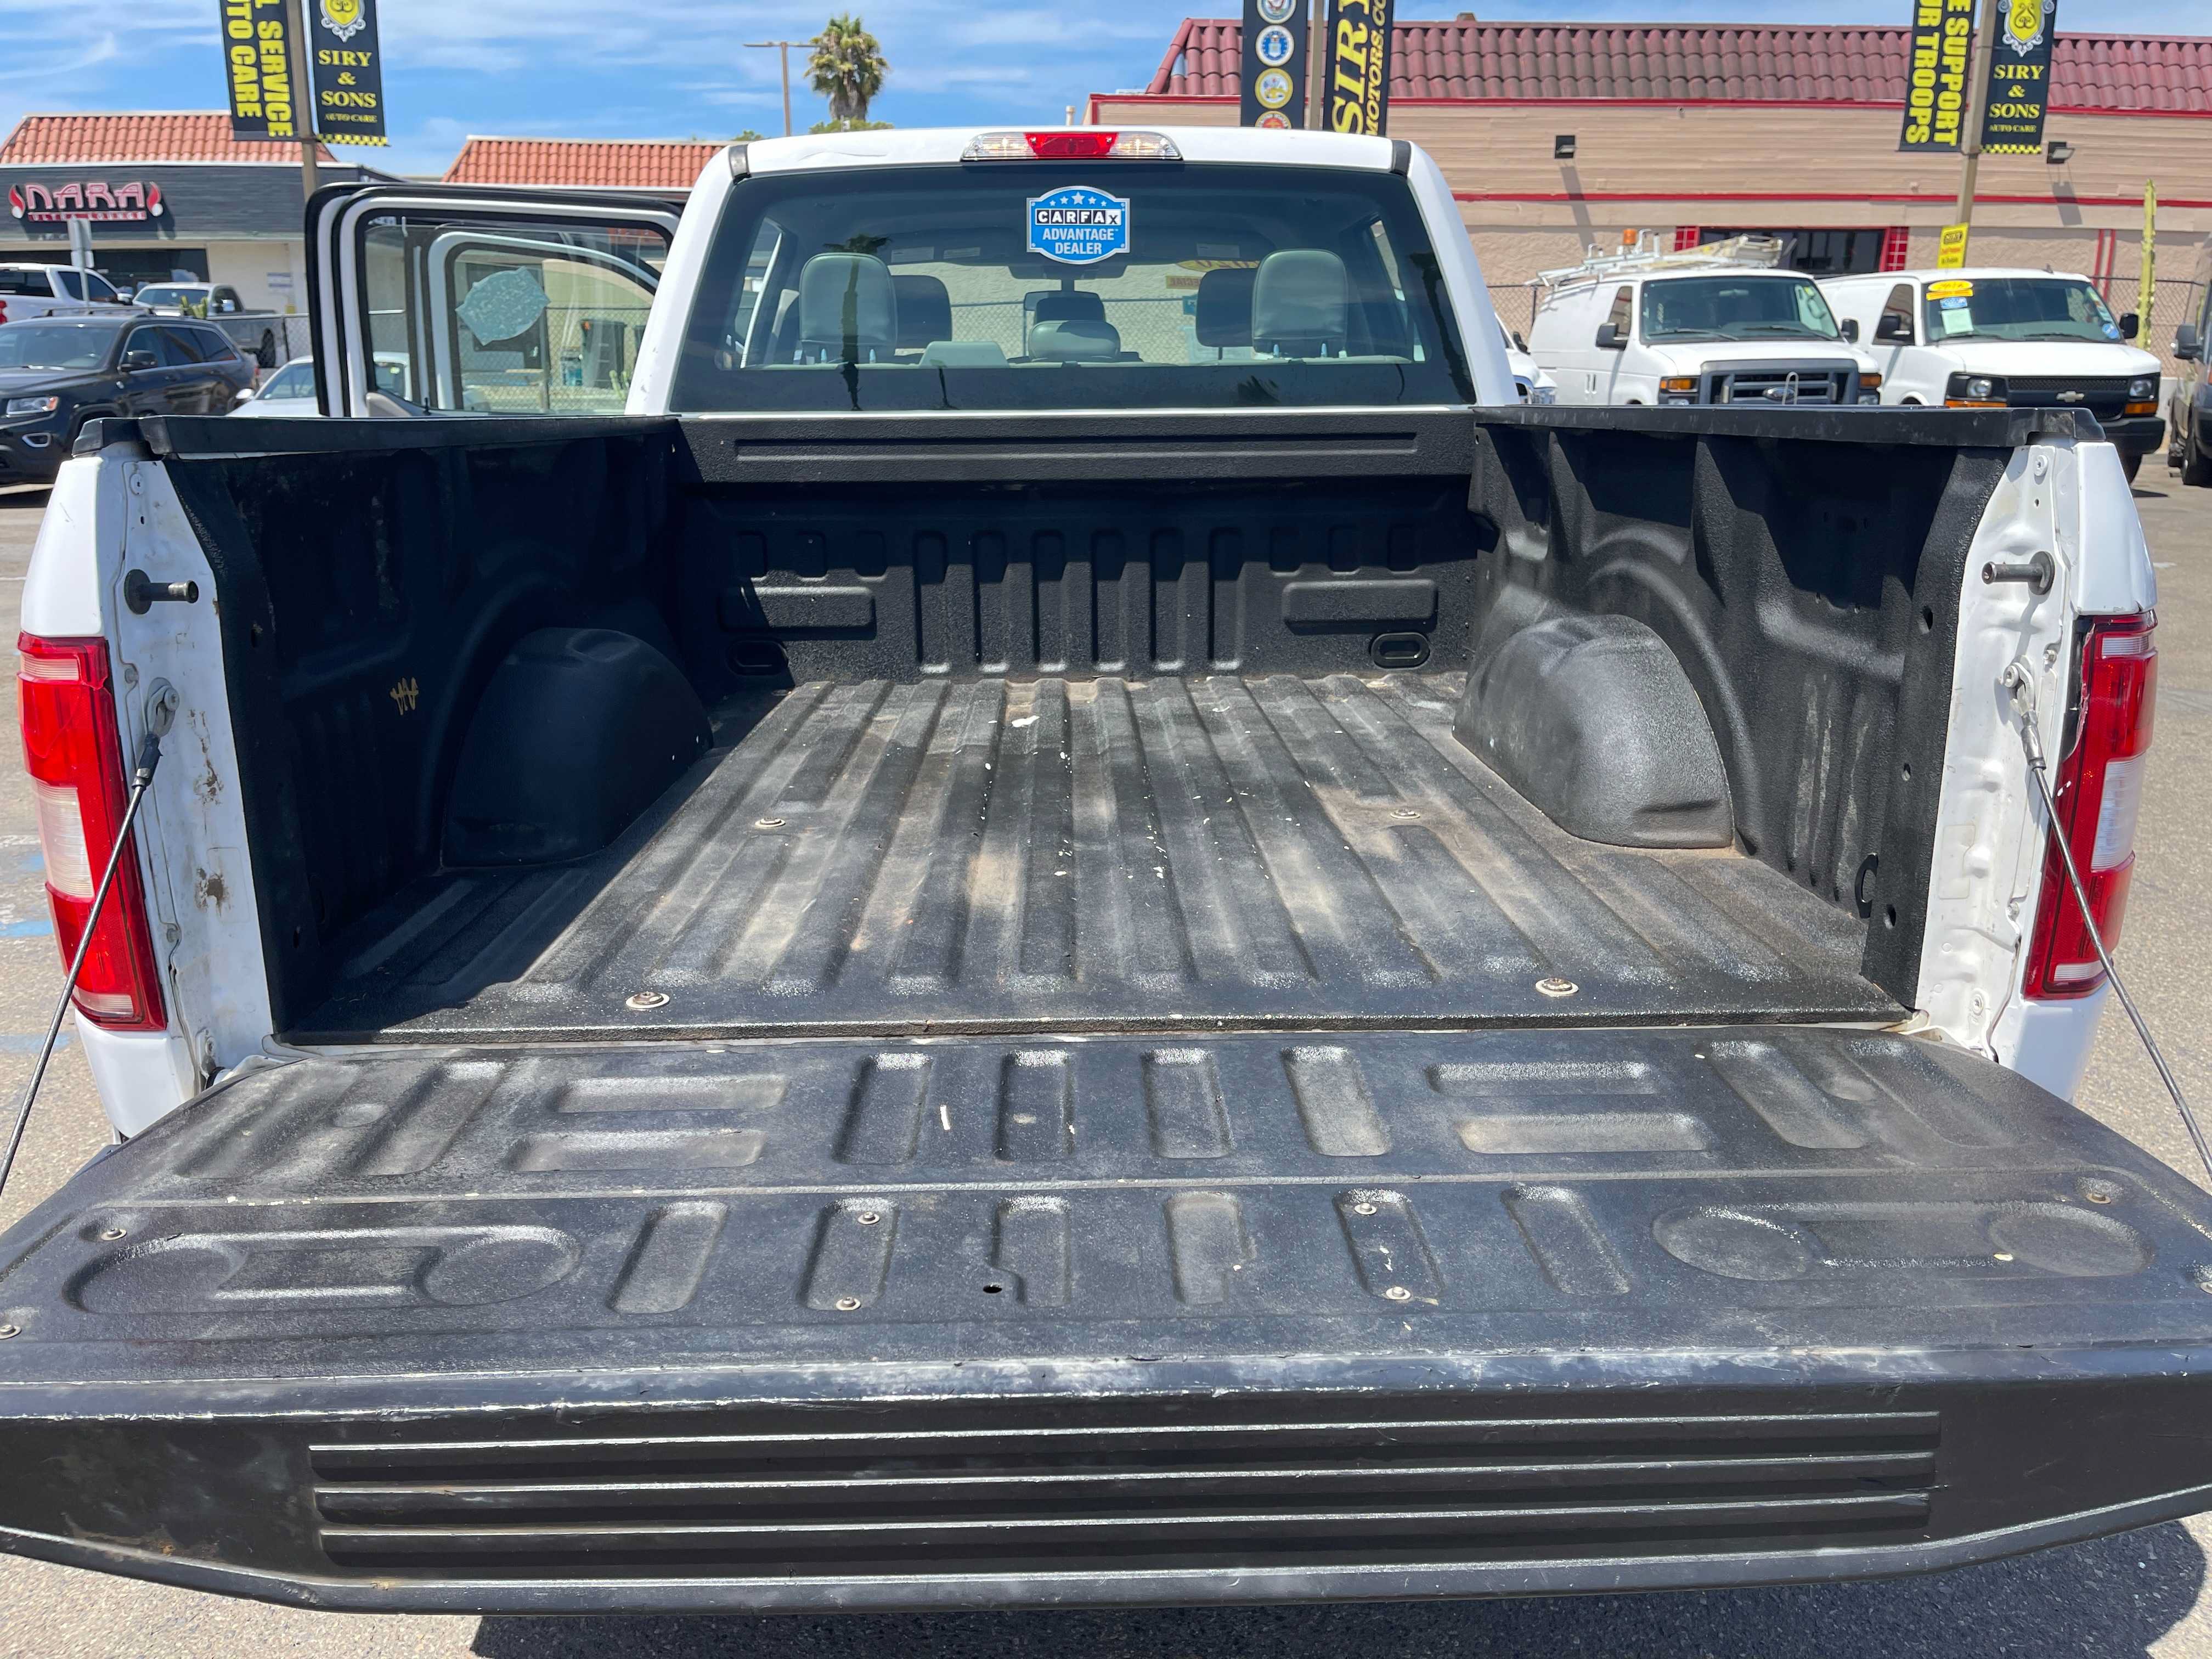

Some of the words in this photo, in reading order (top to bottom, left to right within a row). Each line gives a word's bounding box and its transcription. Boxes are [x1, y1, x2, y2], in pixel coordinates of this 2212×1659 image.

[318, 49, 371, 67] SIRY
[257, 20, 293, 137] SERVICE
[337, 72, 356, 86] &
[1994, 64, 2044, 80] SIRY
[230, 45, 262, 118] CARE
[1905, 32, 1940, 144] TROOPS
[1933, 17, 1970, 146] SUPPORT
[321, 90, 377, 108] SONS
[2007, 84, 2025, 98] &
[1989, 103, 2040, 119] SONS
[26, 182, 145, 210] NARA
[1038, 211, 1119, 224] CARFAX
[1055, 242, 1102, 255] DEALER
